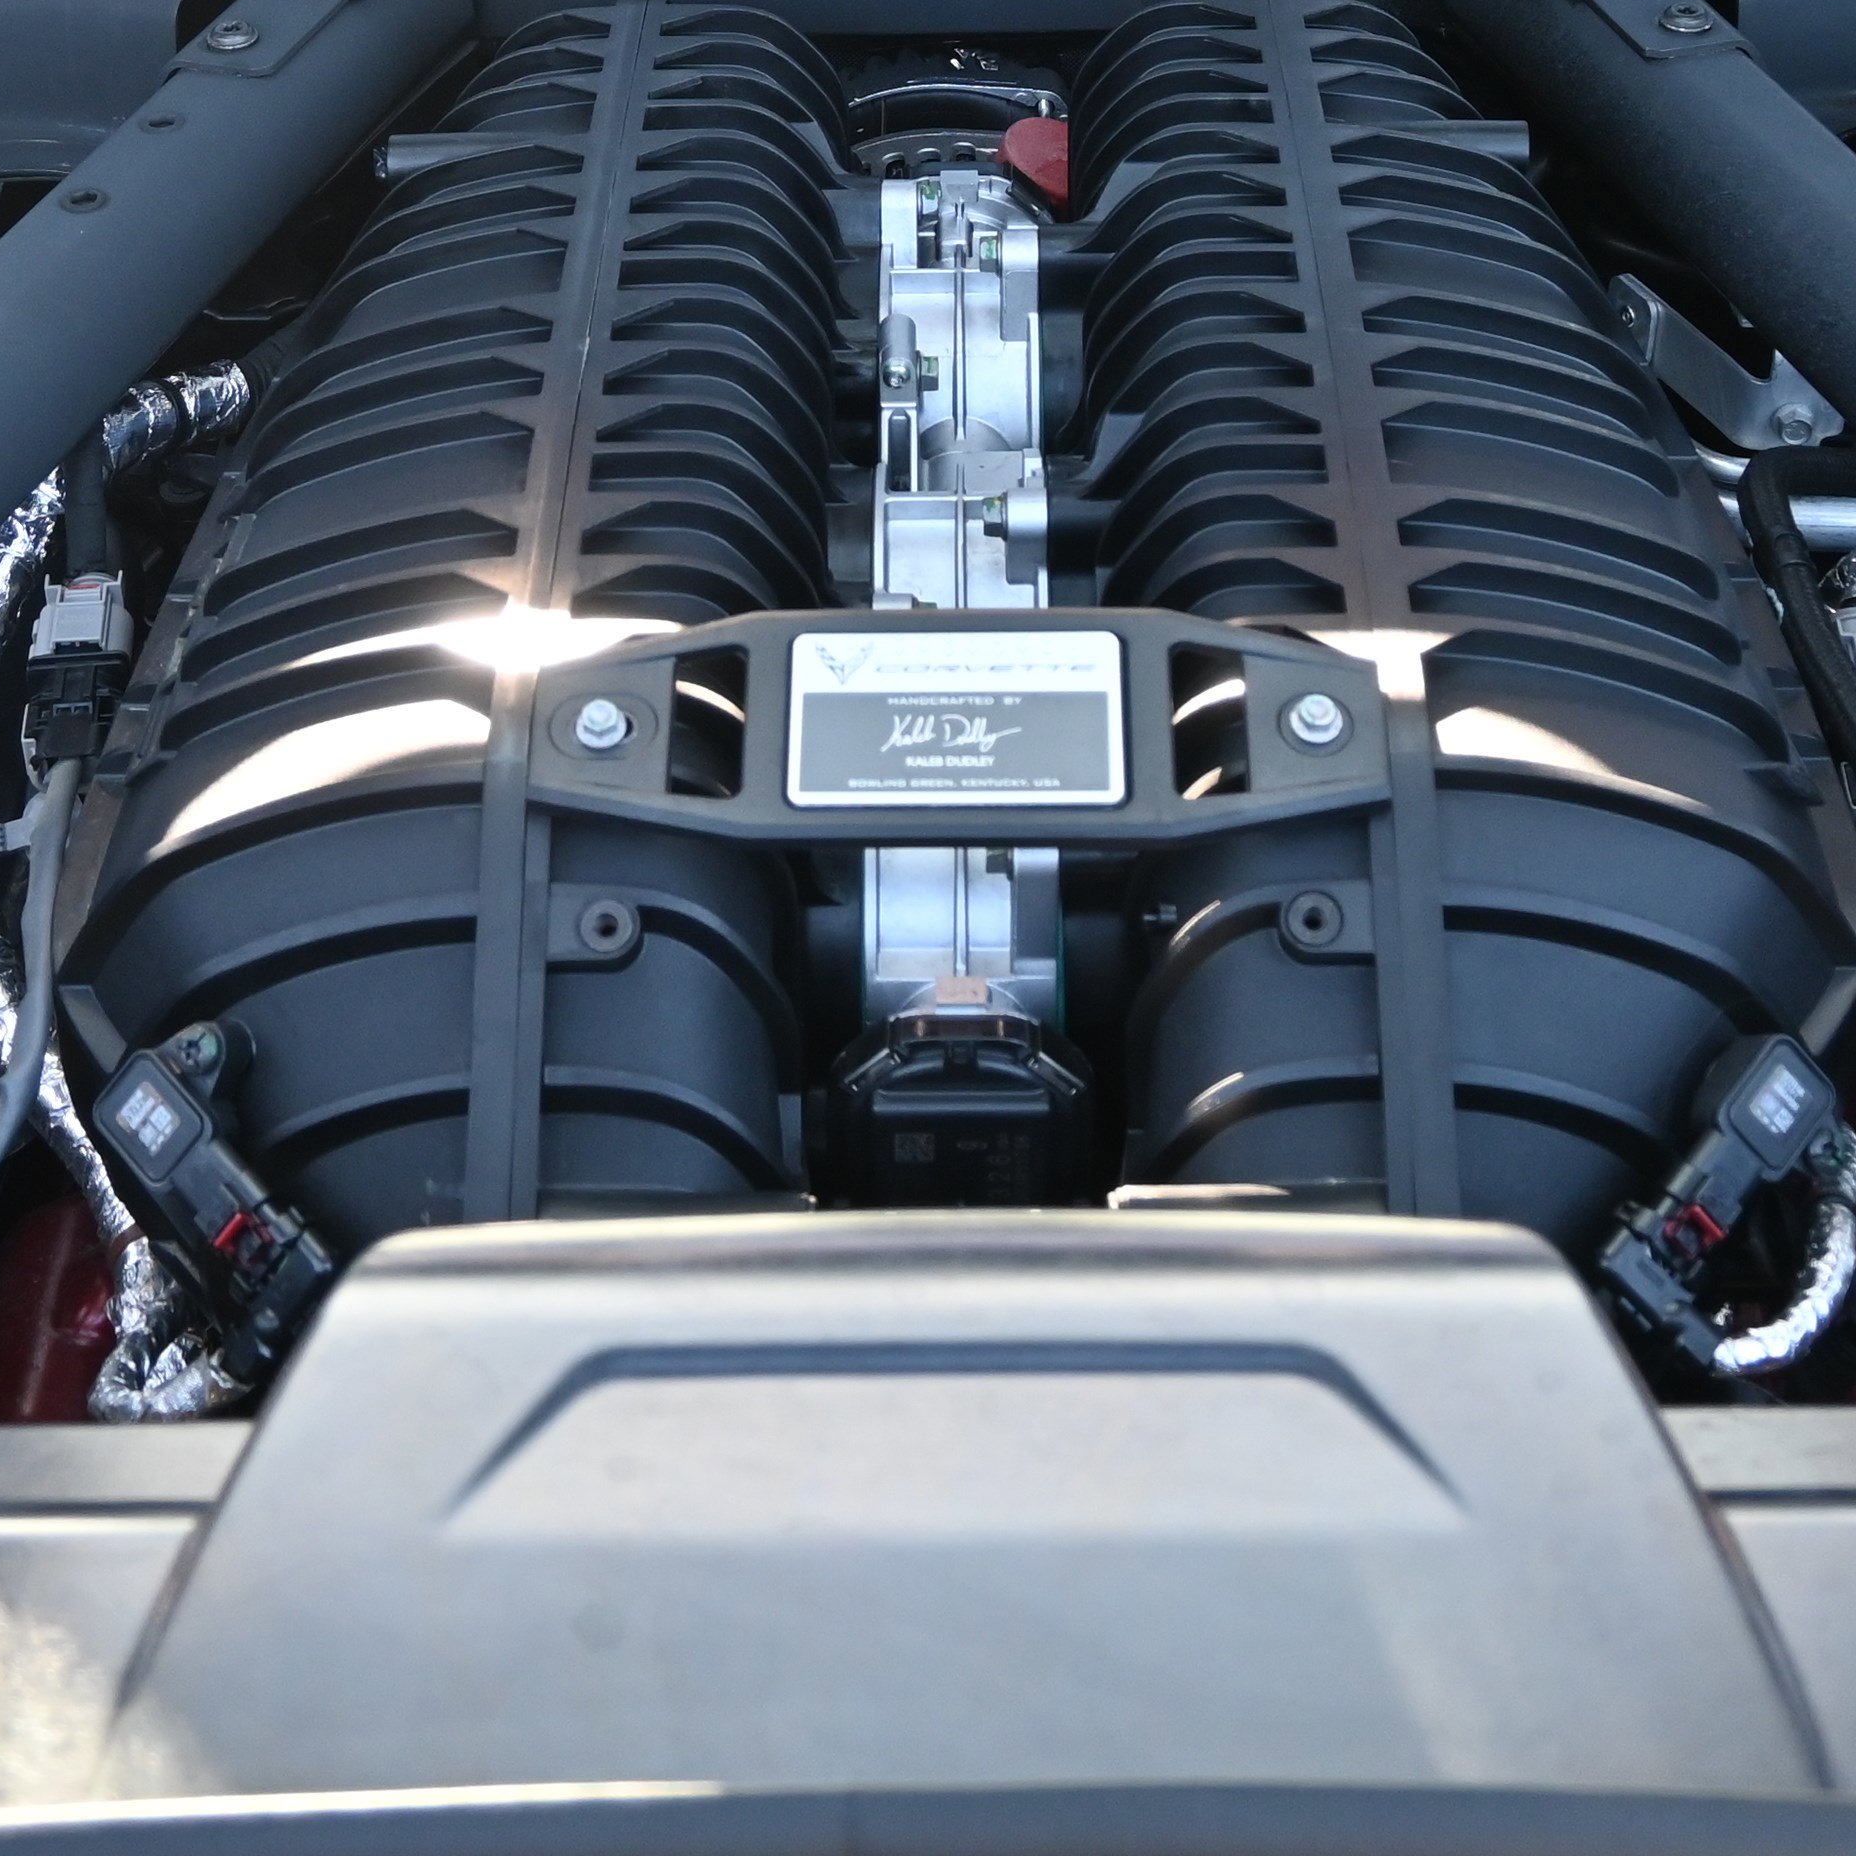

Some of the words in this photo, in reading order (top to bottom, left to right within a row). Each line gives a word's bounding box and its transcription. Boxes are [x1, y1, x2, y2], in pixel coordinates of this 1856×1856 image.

[875, 663, 1097, 673] CORVETTE
[887, 696, 995, 706] HANDCRAFTED
[1003, 696, 1022, 706] BY
[946, 754, 996, 767] DUDLEY
[848, 778, 907, 788] BOWLING
[1032, 778, 1061, 788] USA
